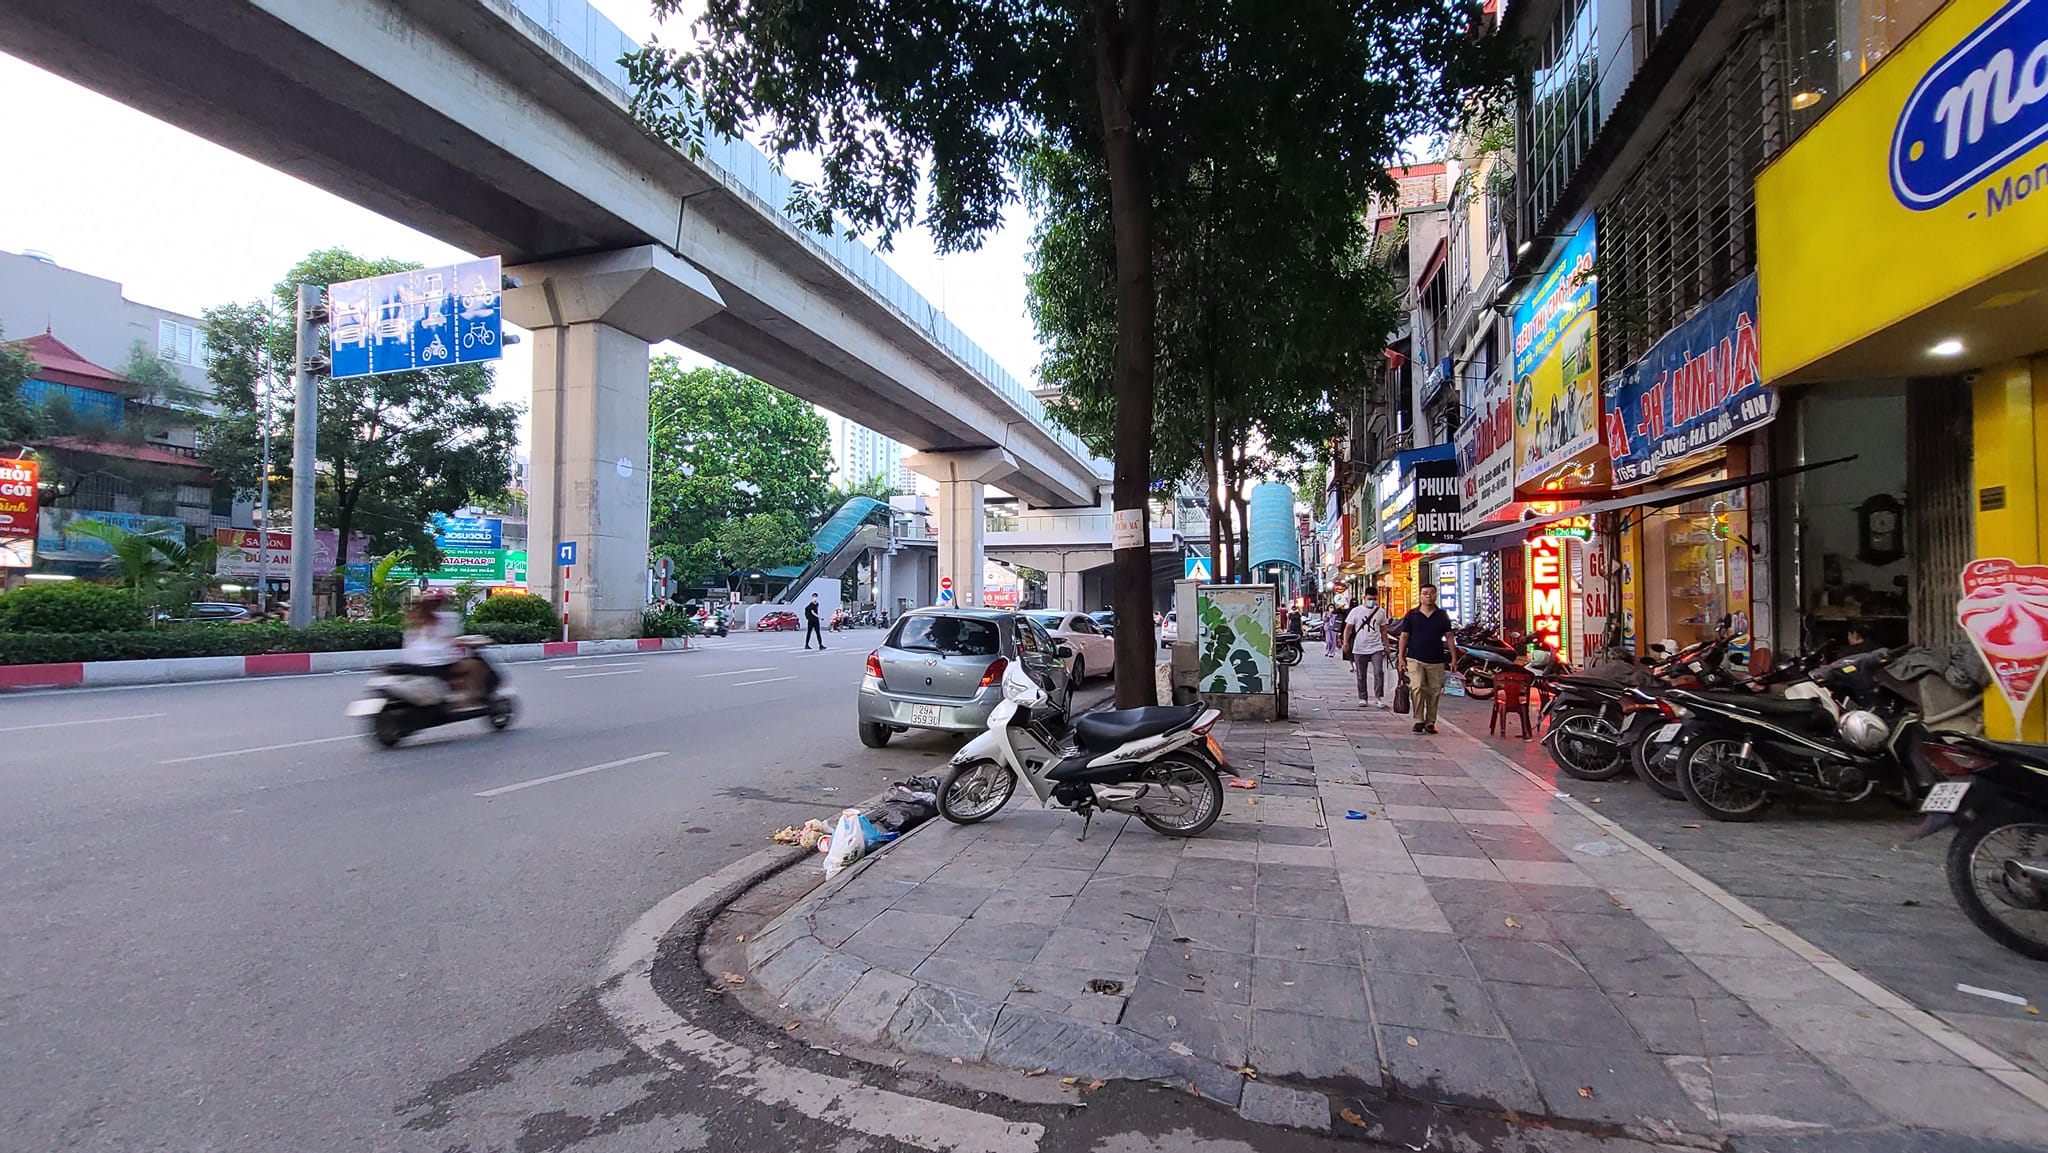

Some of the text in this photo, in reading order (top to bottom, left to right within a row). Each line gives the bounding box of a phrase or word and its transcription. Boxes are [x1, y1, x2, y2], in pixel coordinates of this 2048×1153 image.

[1419, 478, 1444, 501] PHỤ
[1417, 508, 1447, 537] ĐIỆN
[919, 706, 934, 715] 29A
